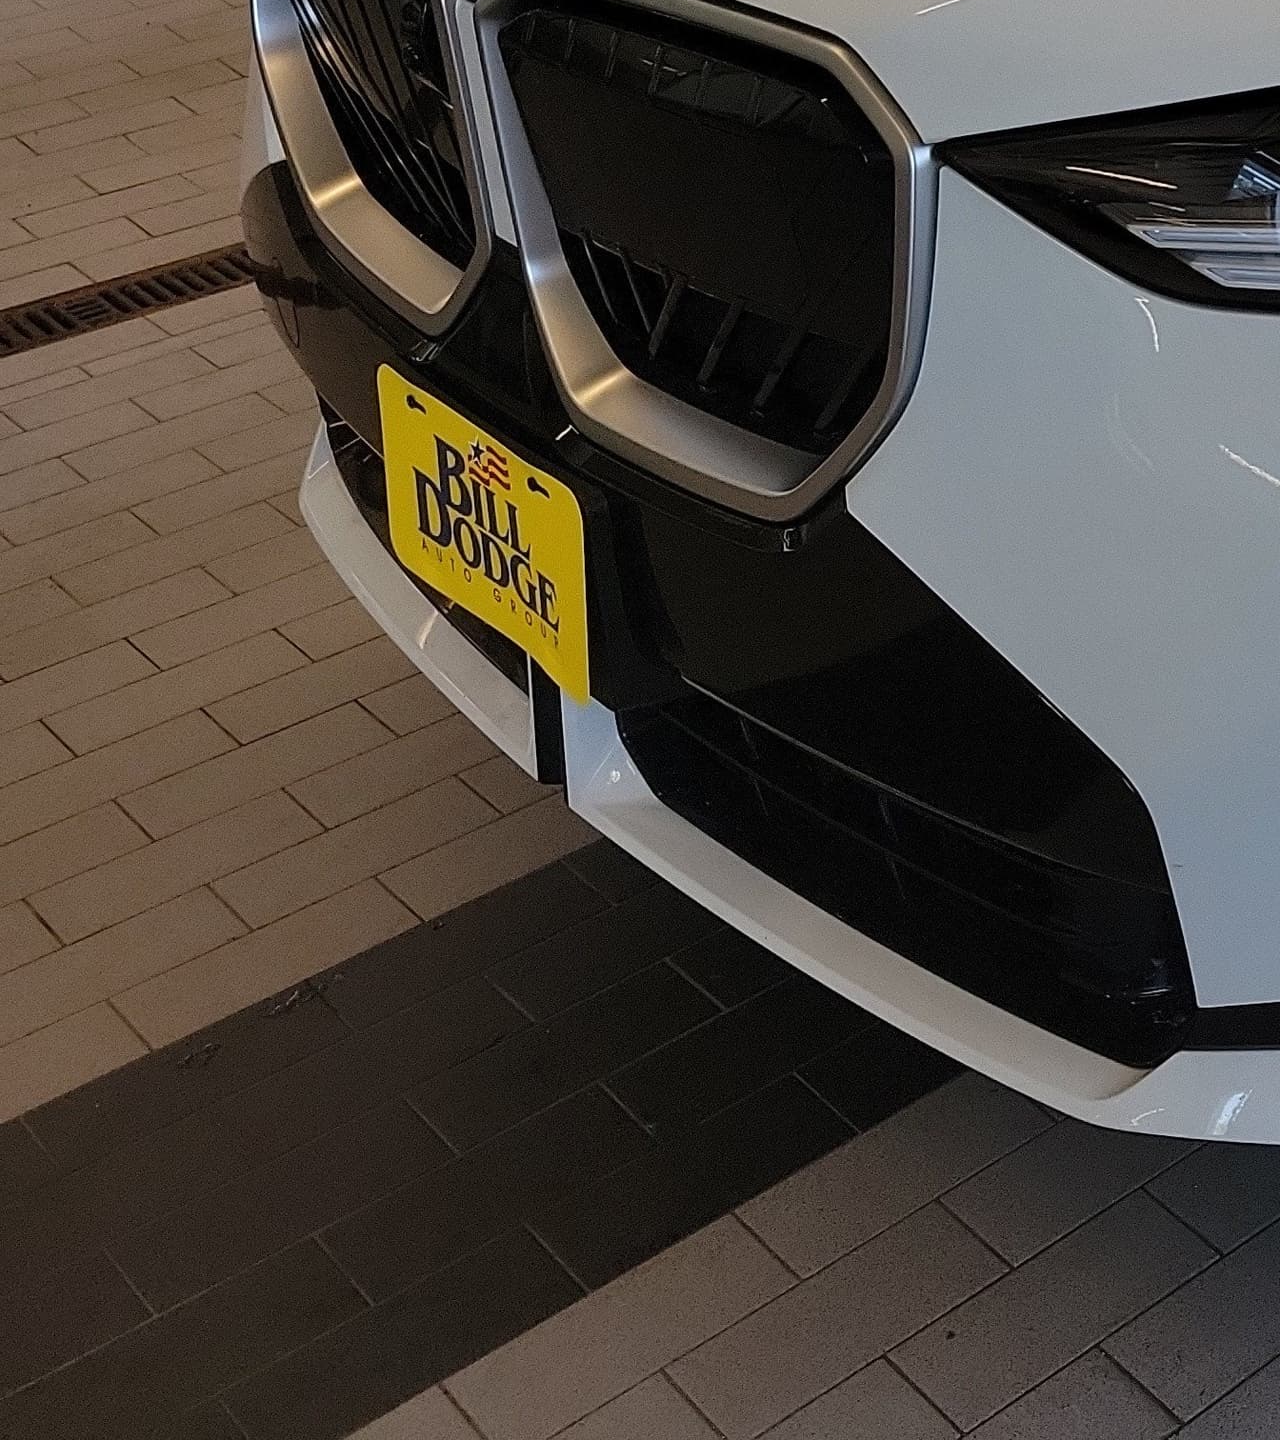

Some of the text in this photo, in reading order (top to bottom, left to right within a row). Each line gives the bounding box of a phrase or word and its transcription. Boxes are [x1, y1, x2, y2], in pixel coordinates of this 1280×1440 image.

[412, 466, 560, 633] DODGE
[434, 434, 531, 562] BILL
[421, 540, 560, 649] AUTO GROUP
